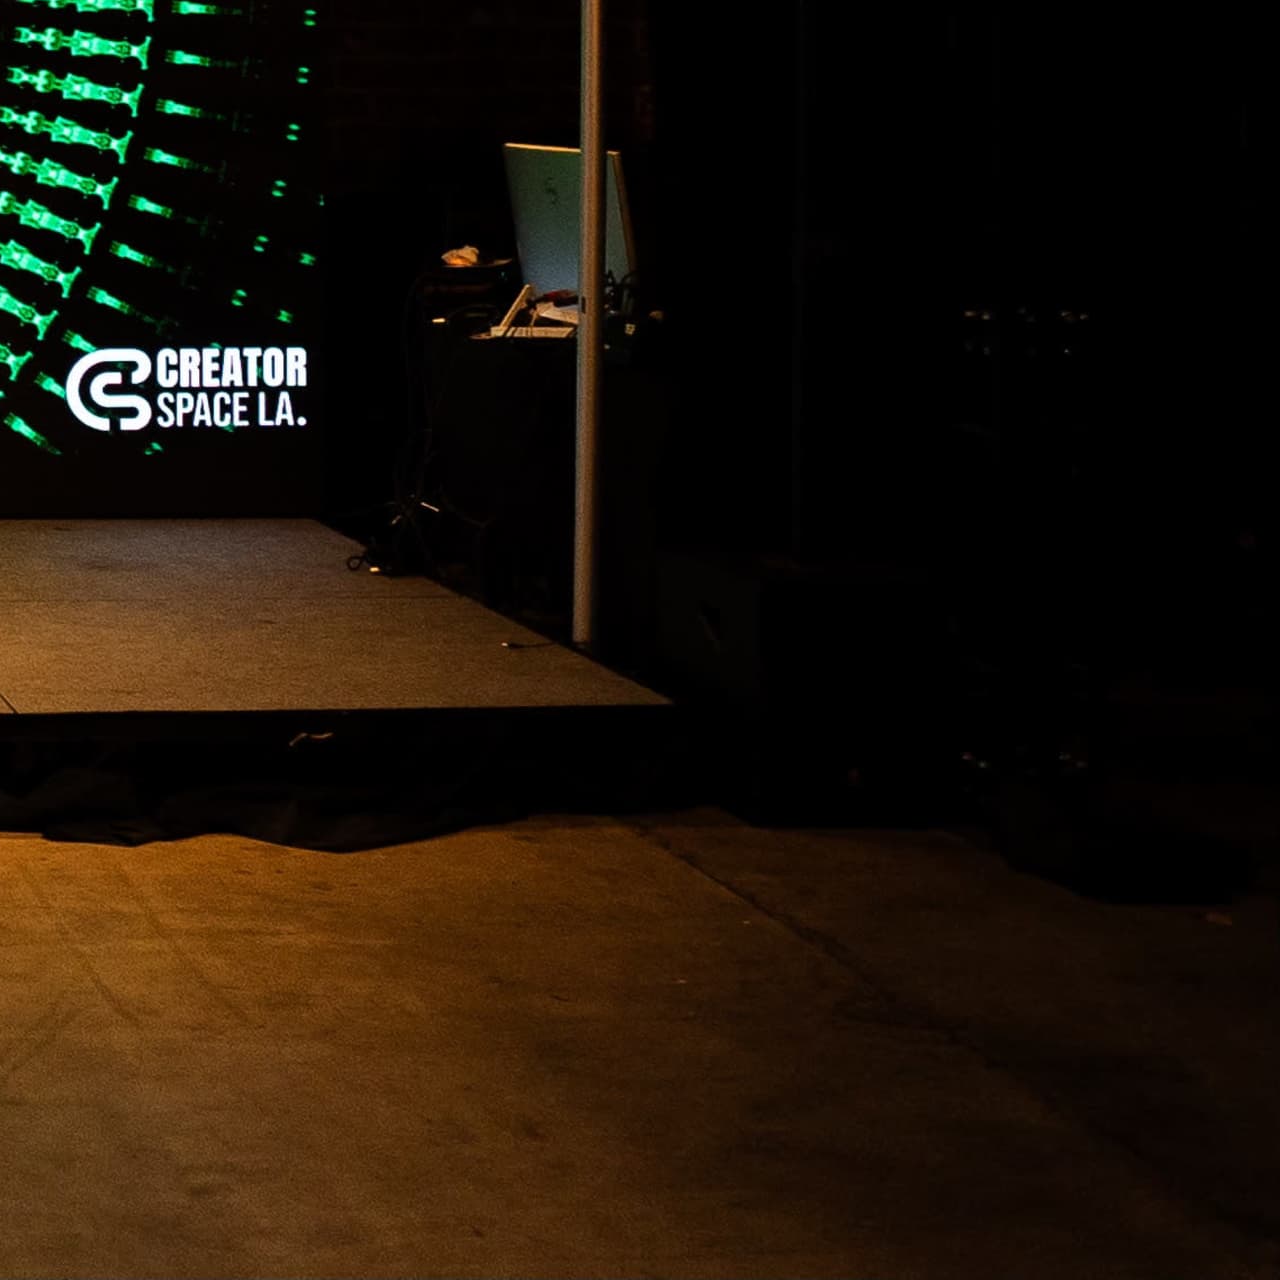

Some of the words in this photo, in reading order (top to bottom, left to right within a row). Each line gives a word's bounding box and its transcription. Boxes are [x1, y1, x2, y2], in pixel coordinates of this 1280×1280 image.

[156, 347, 308, 388] CREATOR
[157, 391, 250, 428] SPACE
[258, 391, 308, 427] LA.
